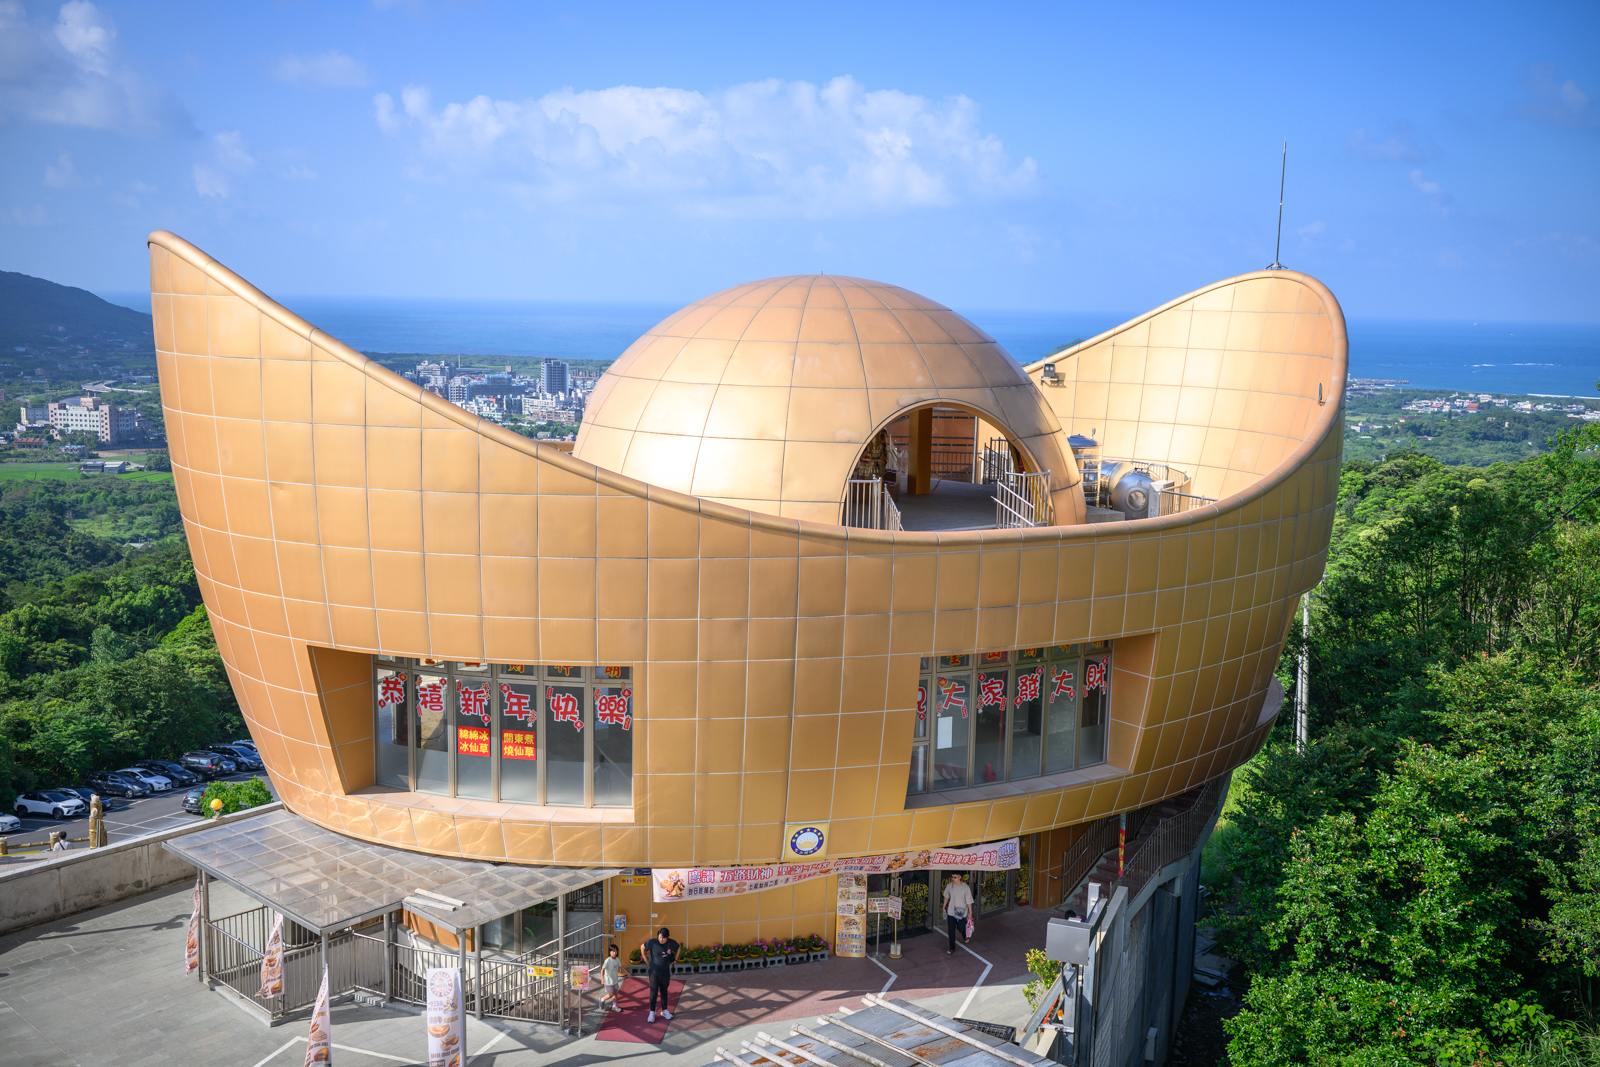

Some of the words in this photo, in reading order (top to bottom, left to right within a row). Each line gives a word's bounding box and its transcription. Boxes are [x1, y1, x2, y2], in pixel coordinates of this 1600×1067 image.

[459, 729, 489, 742] 綿綿冰
[503, 733, 534, 744] 關東煮
[459, 741, 489, 754] 冰仙草
[503, 745, 534, 757] 燒仙草
[720, 867, 773, 883] 五路財神
